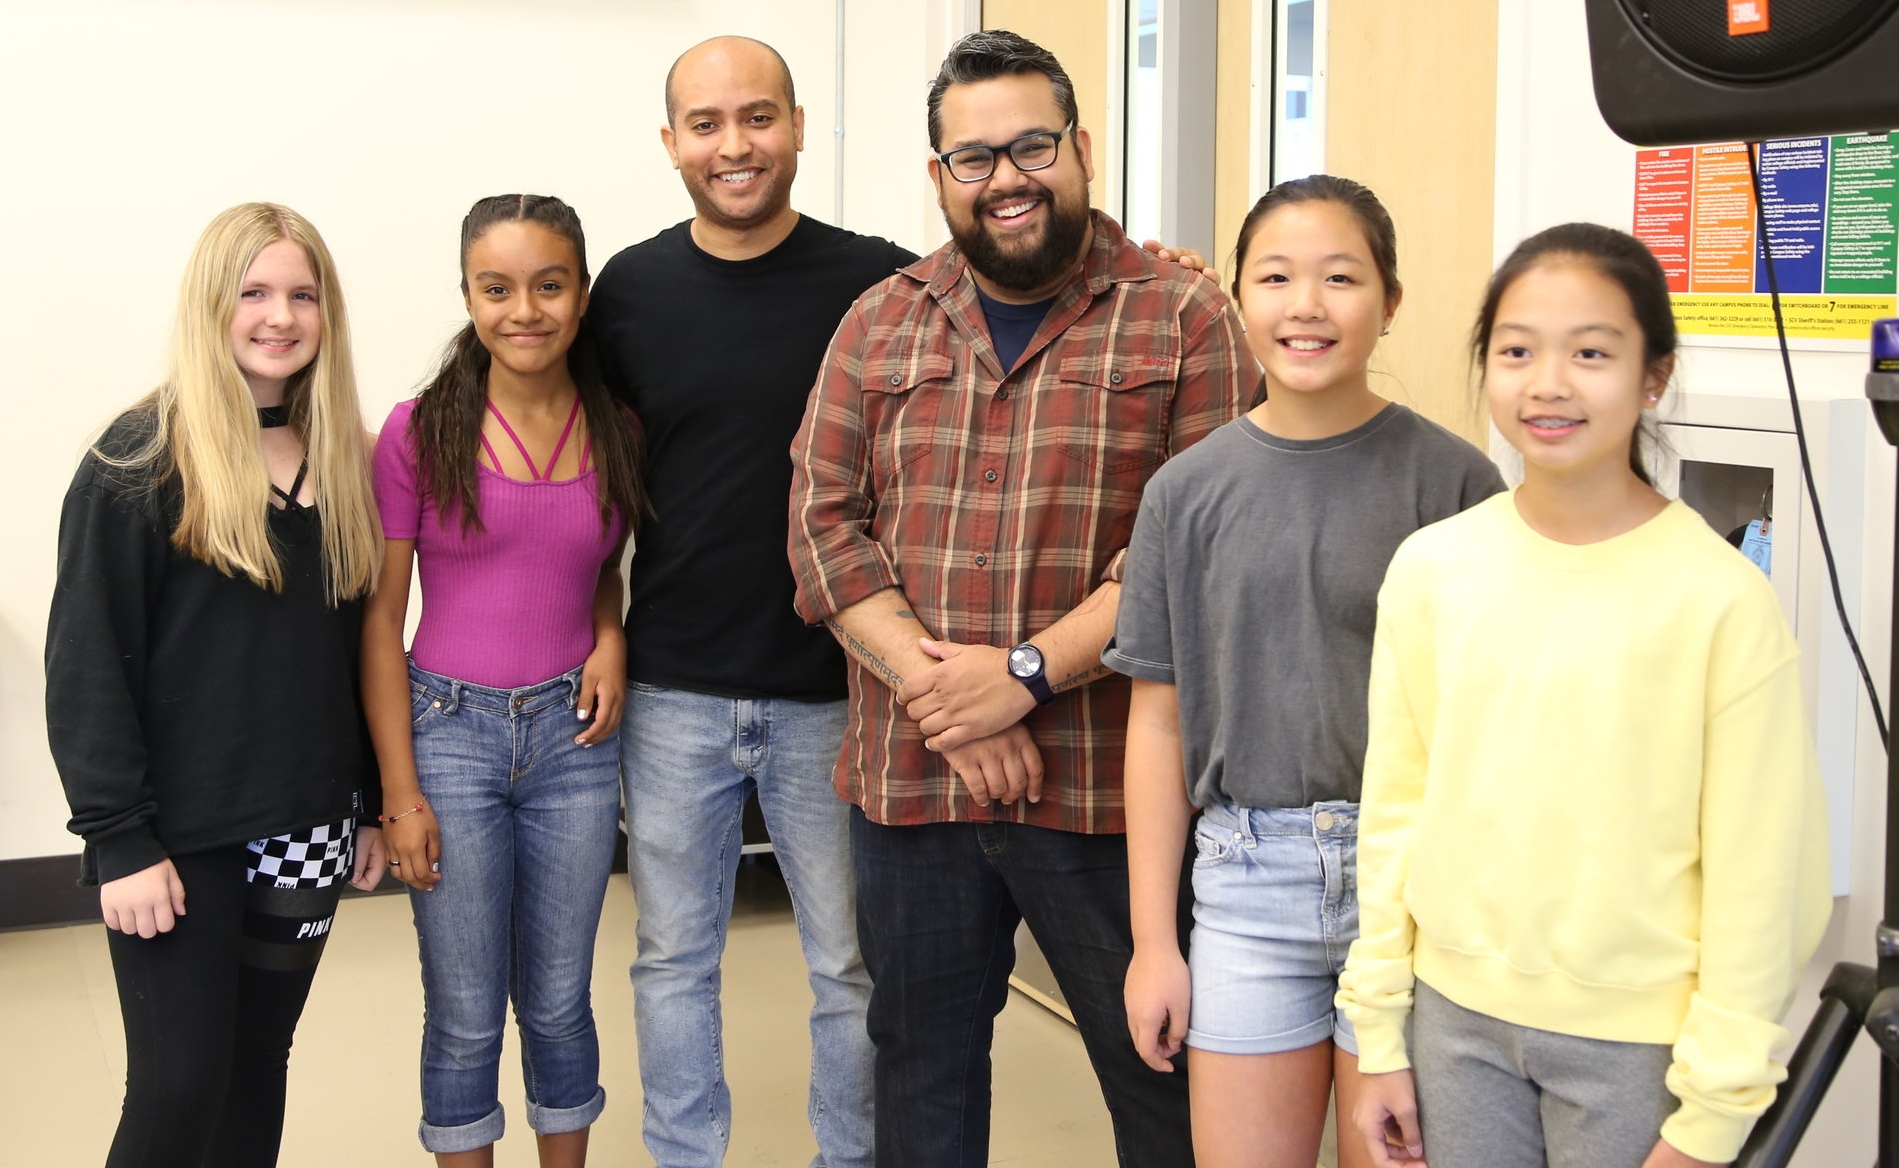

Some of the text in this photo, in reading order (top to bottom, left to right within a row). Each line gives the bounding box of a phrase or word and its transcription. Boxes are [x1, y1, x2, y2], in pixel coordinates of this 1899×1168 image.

[1732, 2, 1761, 24] JBL
[1791, 140, 1821, 148] INCIDENTS
[1847, 135, 1887, 144] EARTHQUAKE
[1830, 301, 1835, 312] 7
[252, 840, 265, 848] INK
[297, 914, 333, 939] PINK
